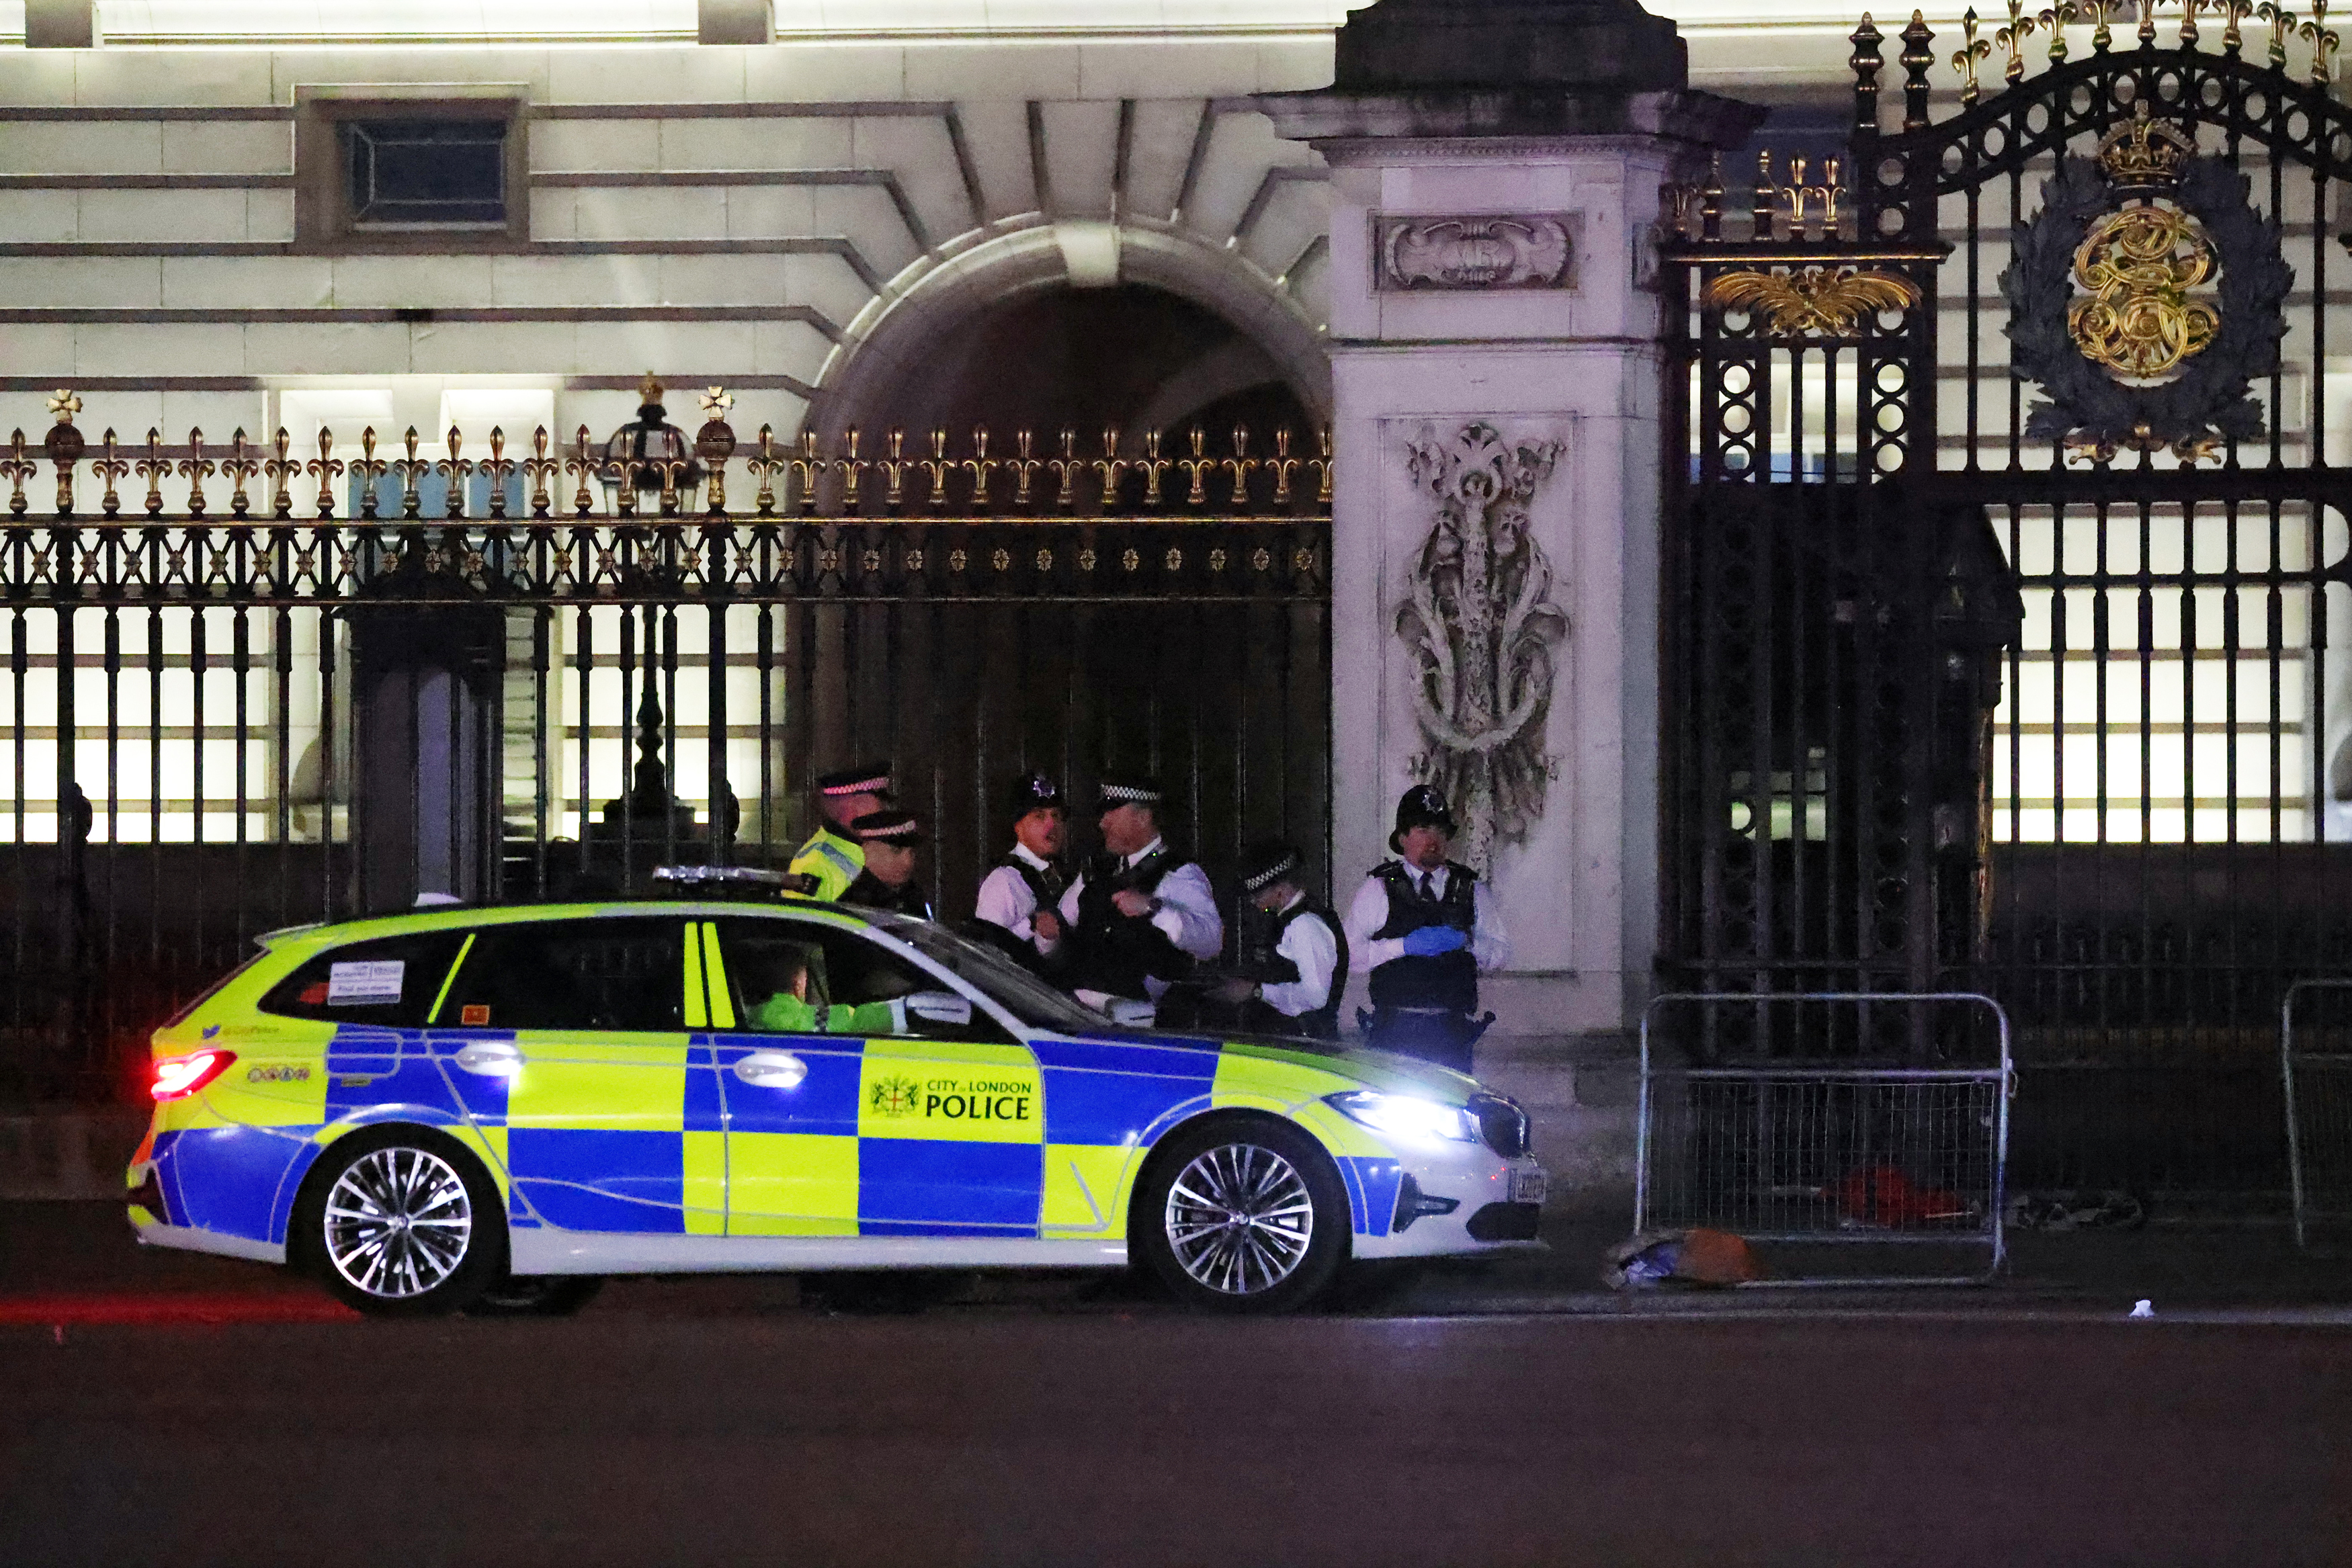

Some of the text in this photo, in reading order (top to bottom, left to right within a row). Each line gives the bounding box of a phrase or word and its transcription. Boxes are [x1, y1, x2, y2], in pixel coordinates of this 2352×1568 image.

[927, 1080, 958, 1092] CITY
[969, 1081, 1032, 1093] LONDON
[926, 1094, 1029, 1120] POLICE
